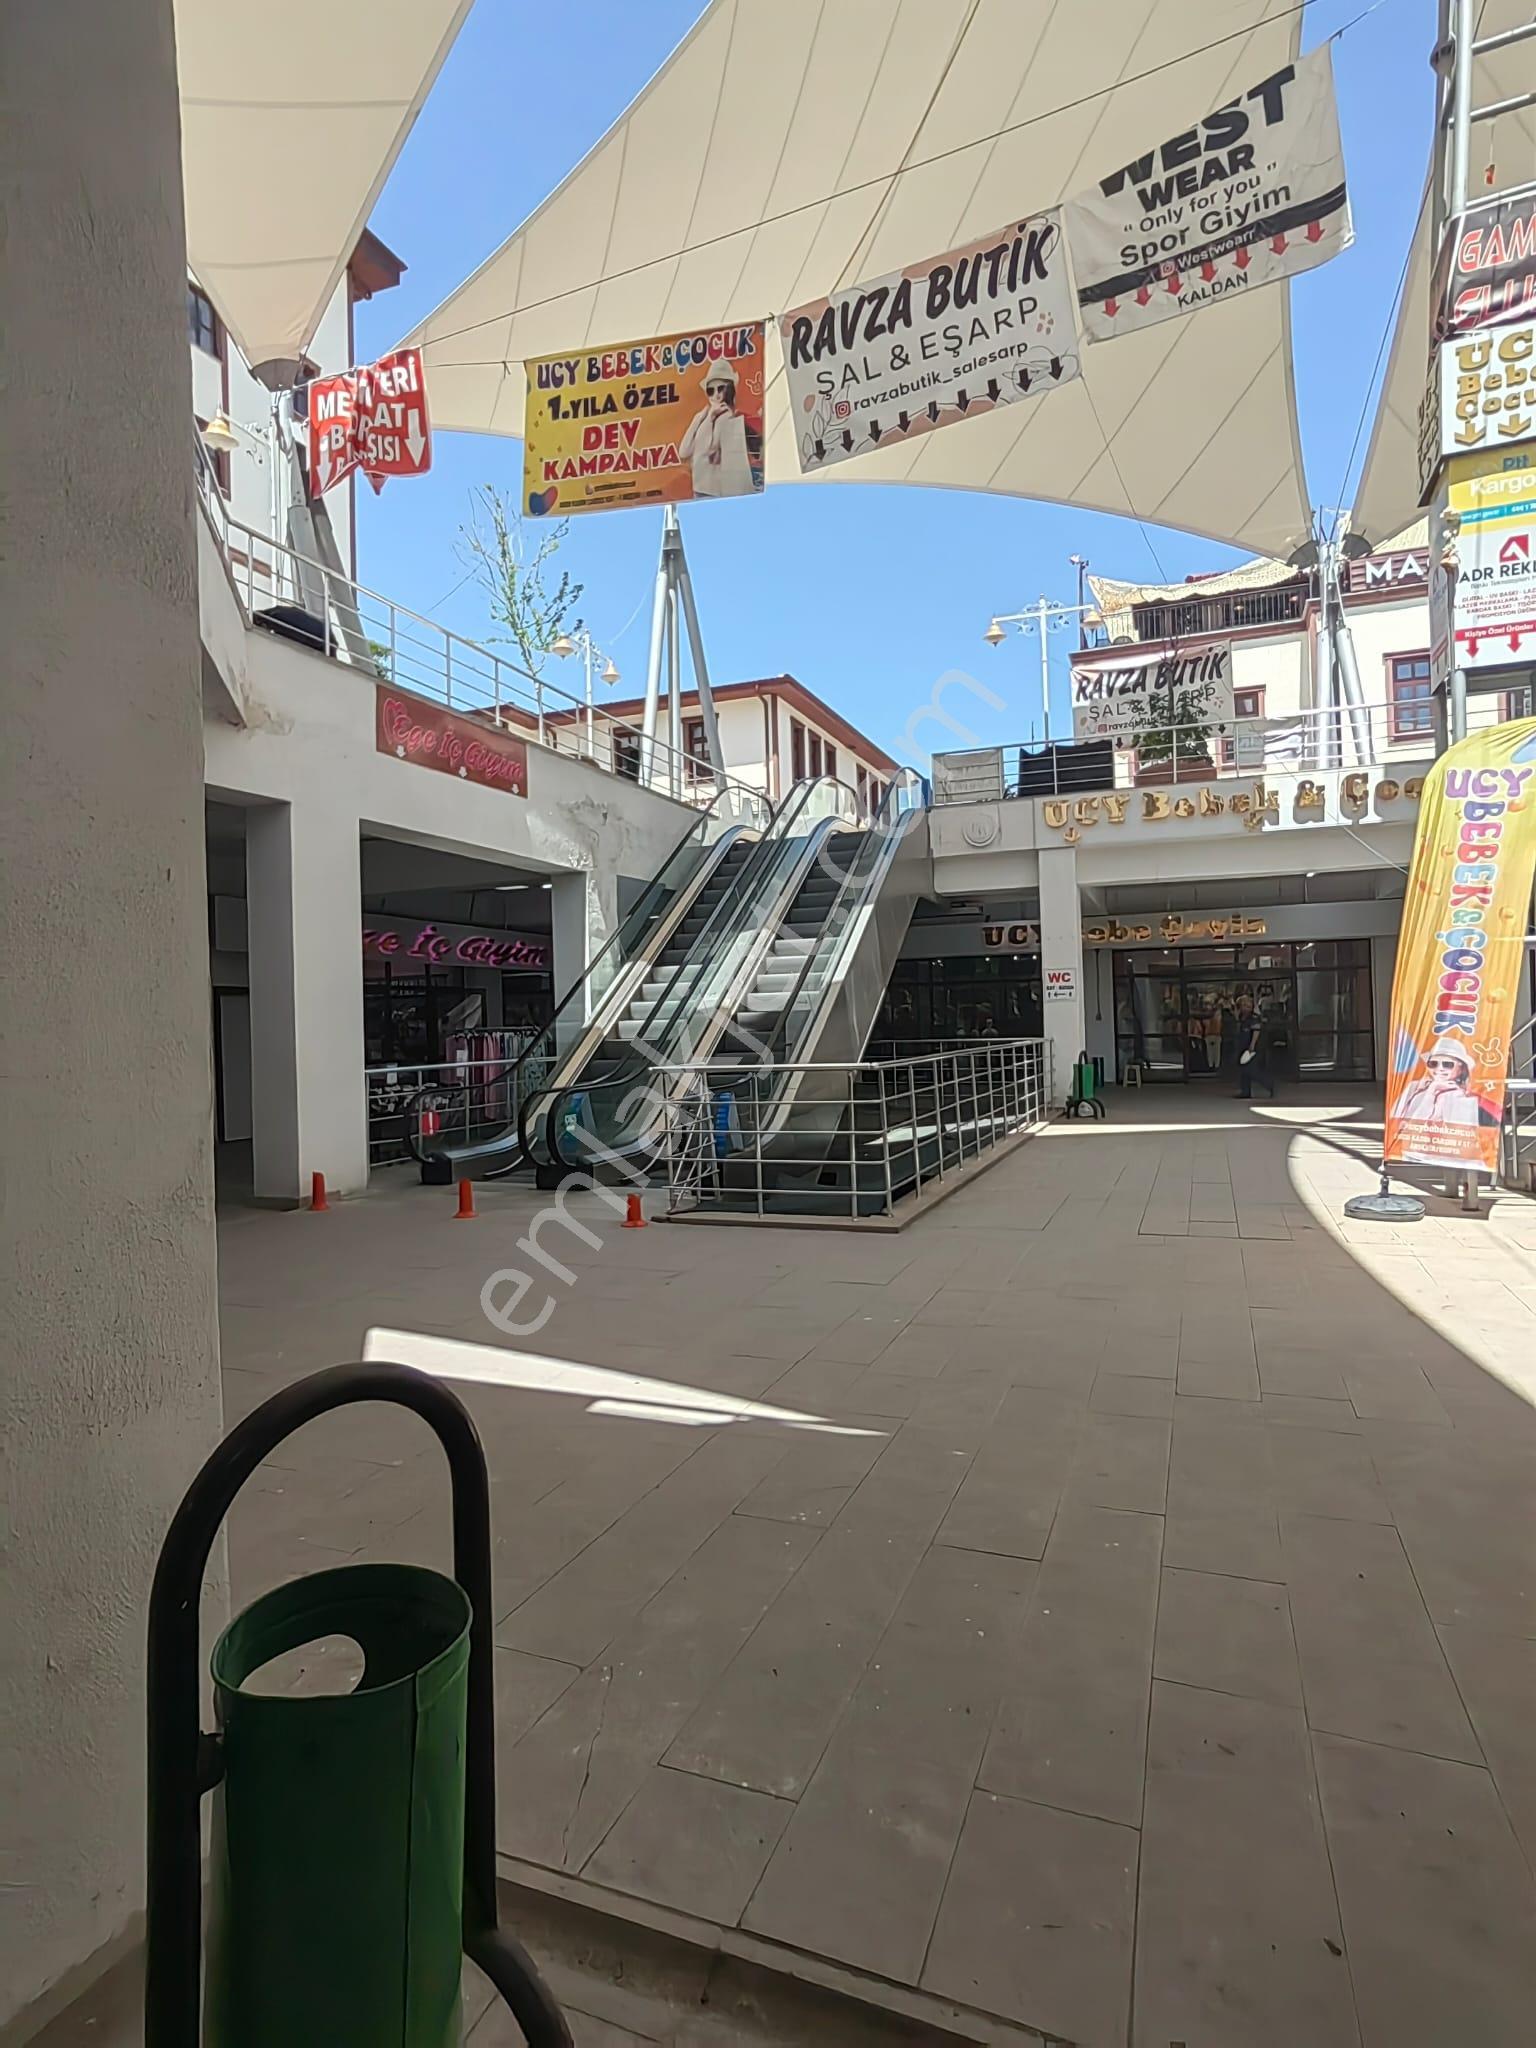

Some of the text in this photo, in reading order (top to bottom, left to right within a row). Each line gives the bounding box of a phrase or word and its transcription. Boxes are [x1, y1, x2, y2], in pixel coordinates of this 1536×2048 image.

[1099, 64, 1295, 198] WEST
[1137, 144, 1256, 213] WEAR
[1139, 175, 1261, 234] Only for you
[1120, 185, 1291, 268] Spor Giyim
[789, 223, 1055, 369] RAVZA BUTİK
[1177, 271, 1249, 308] KALDAN
[816, 297, 1039, 400] ŞAL & EŞARP
[537, 358, 580, 390] UCY
[854, 342, 1029, 411] ravzabutik_salesarp
[623, 382, 681, 410] ÖZEL
[582, 419, 641, 451] DEV
[543, 443, 681, 482] KAMPANYA
[1470, 474, 1536, 496] Kargo
[1366, 553, 1429, 584] MA
[1459, 567, 1494, 584] ADR
[1076, 646, 1227, 702] RAVZA BUTİK
[1089, 702, 1126, 722] ŞAL
[464, 740, 523, 782] Giyim
[1444, 767, 1535, 798] UCY
[1042, 795, 1130, 828] UCY
[1083, 918, 1151, 945] ebe
[456, 935, 547, 967] Giyim
[1047, 972, 1072, 983] WC
